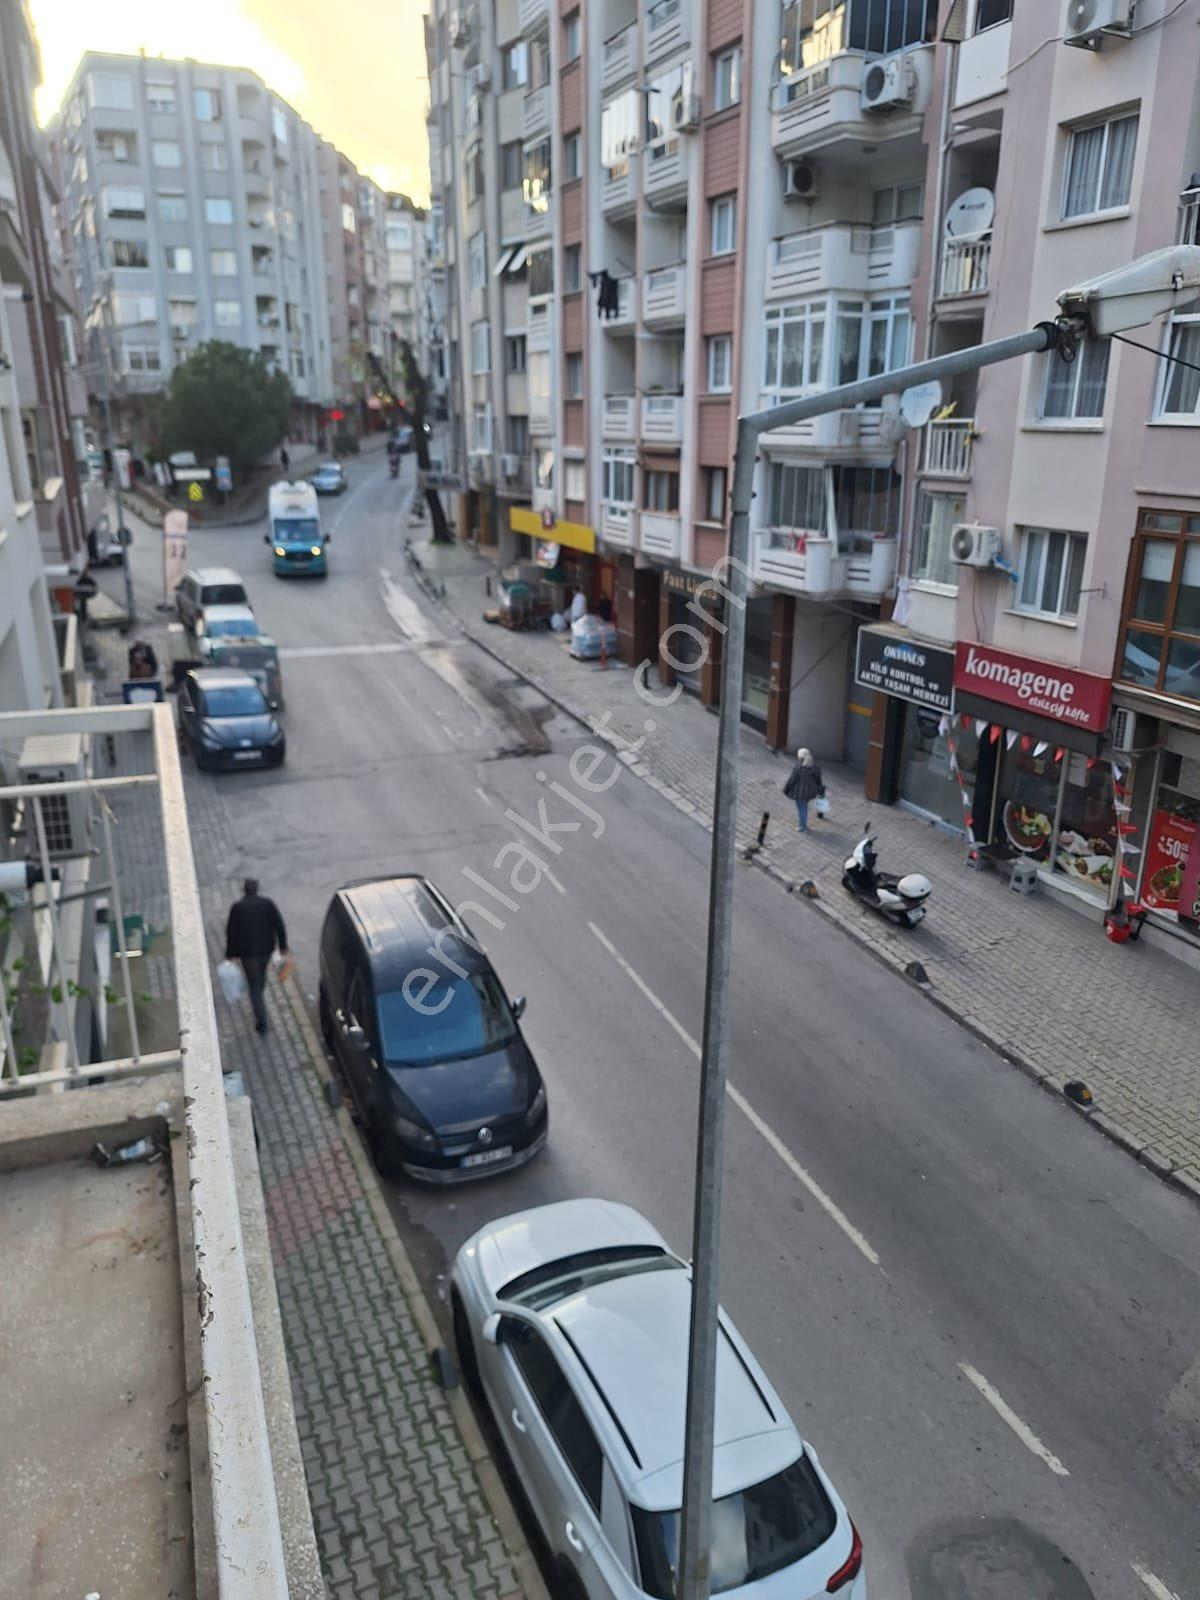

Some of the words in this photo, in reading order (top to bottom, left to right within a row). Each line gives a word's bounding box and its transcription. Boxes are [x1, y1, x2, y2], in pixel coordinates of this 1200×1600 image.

[889, 667, 926, 687] KONTROL
[965, 648, 1075, 702] komagene
[884, 678, 911, 694] YAŞAM
[912, 687, 949, 707] MERKEZİ
